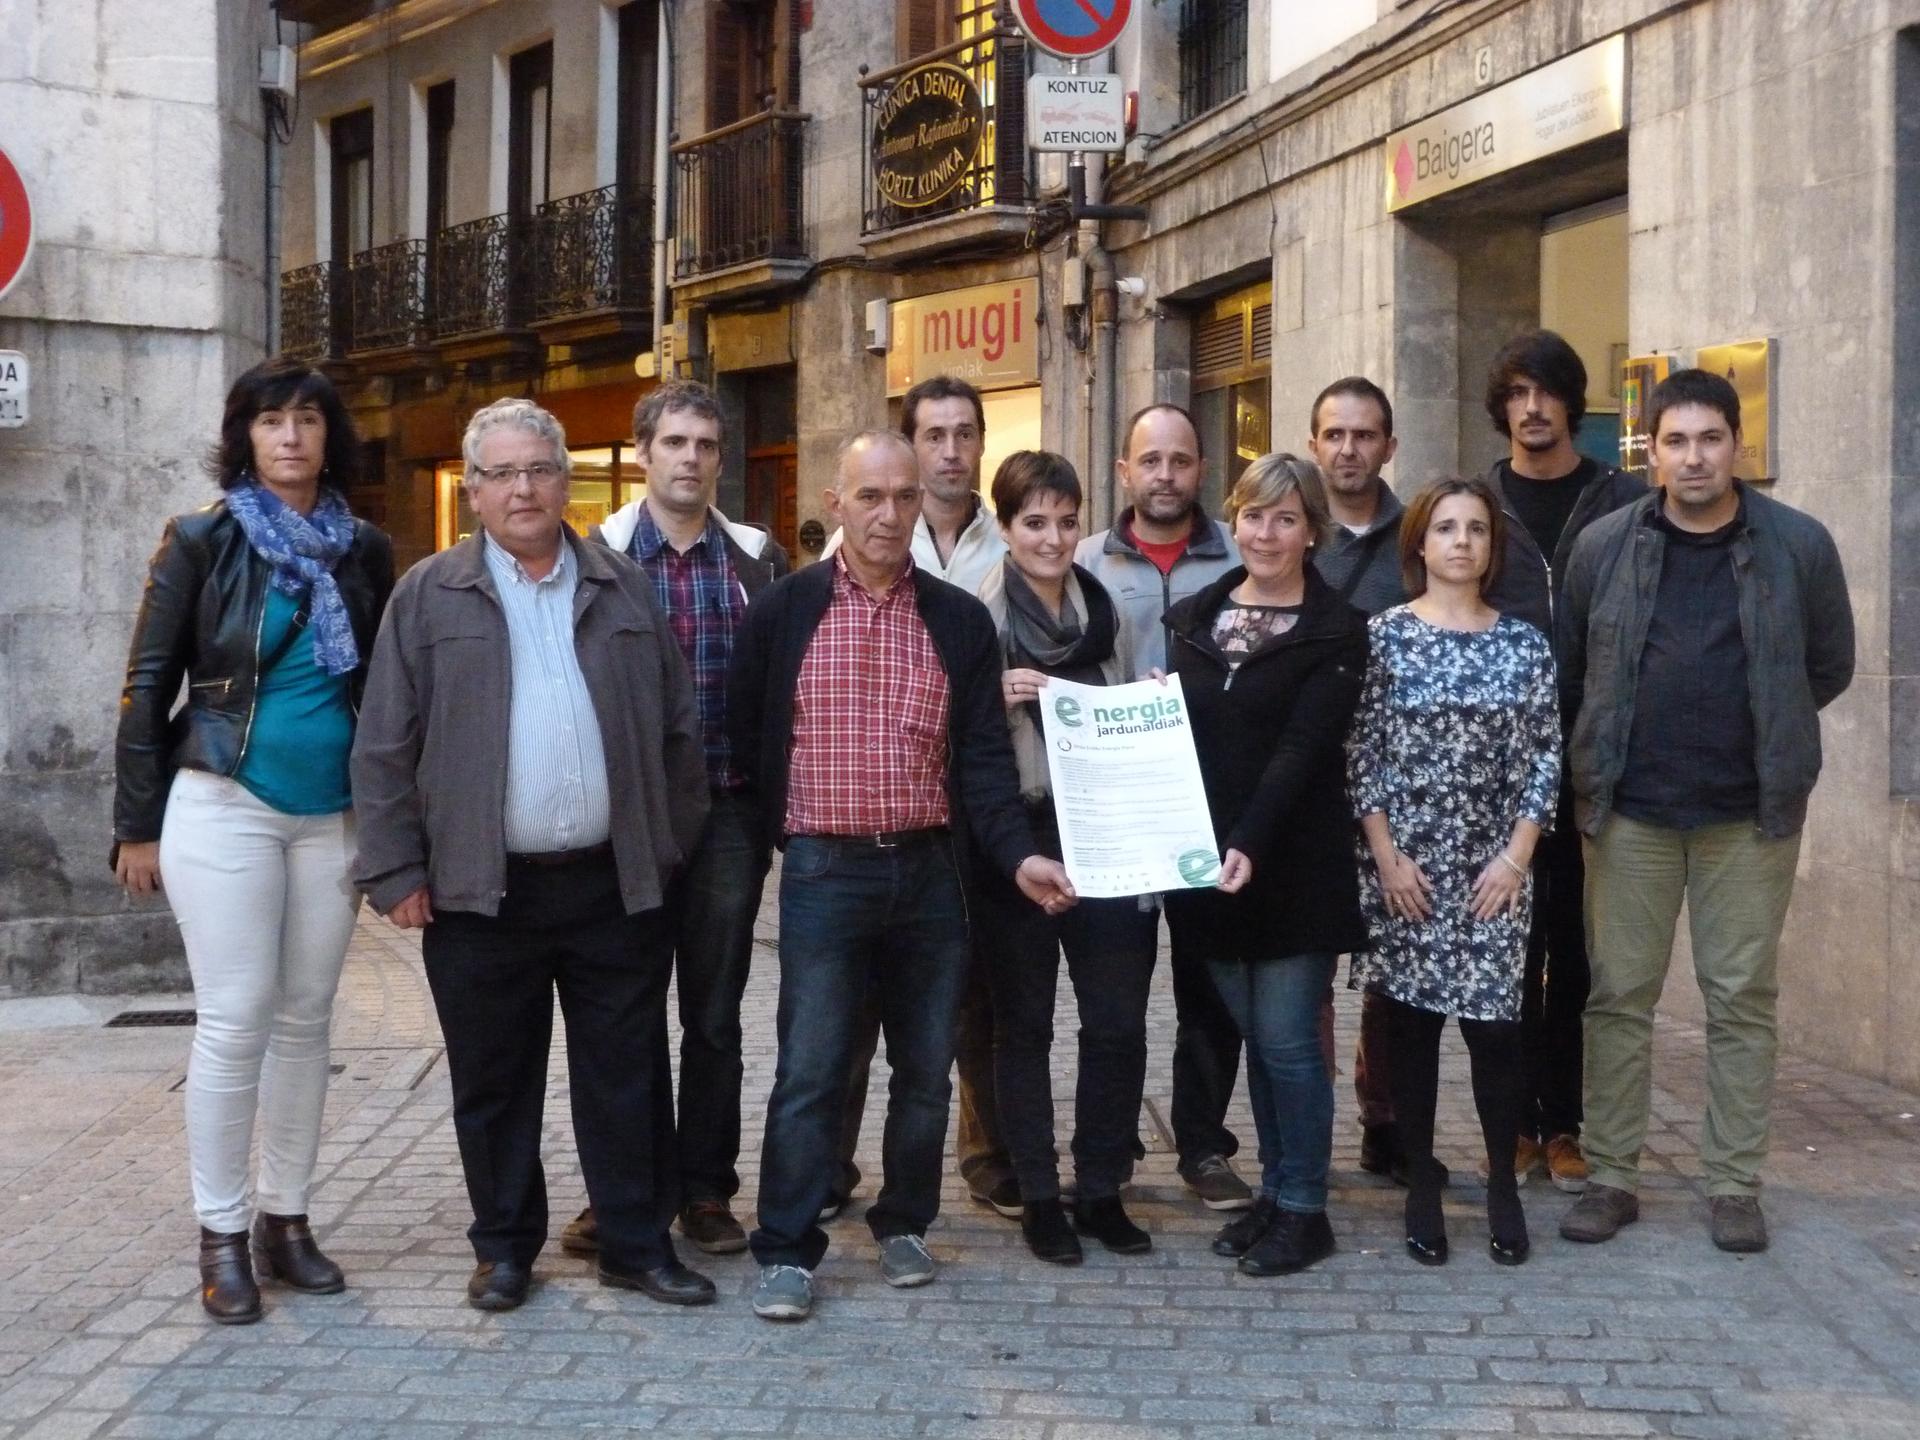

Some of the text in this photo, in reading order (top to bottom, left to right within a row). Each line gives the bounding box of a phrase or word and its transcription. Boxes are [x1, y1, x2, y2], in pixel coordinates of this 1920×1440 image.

[1479, 51, 1489, 81] 6
[924, 72, 967, 108] DENTAL
[1047, 80, 1109, 95] KONTUZ
[1043, 130, 1118, 145] ATENCION
[1416, 120, 1496, 181] Baigera
[879, 146, 965, 199] HORTZ KLINIKA
[923, 288, 1022, 362] mugi
[1096, 715, 1185, 738] jardunaldiak
